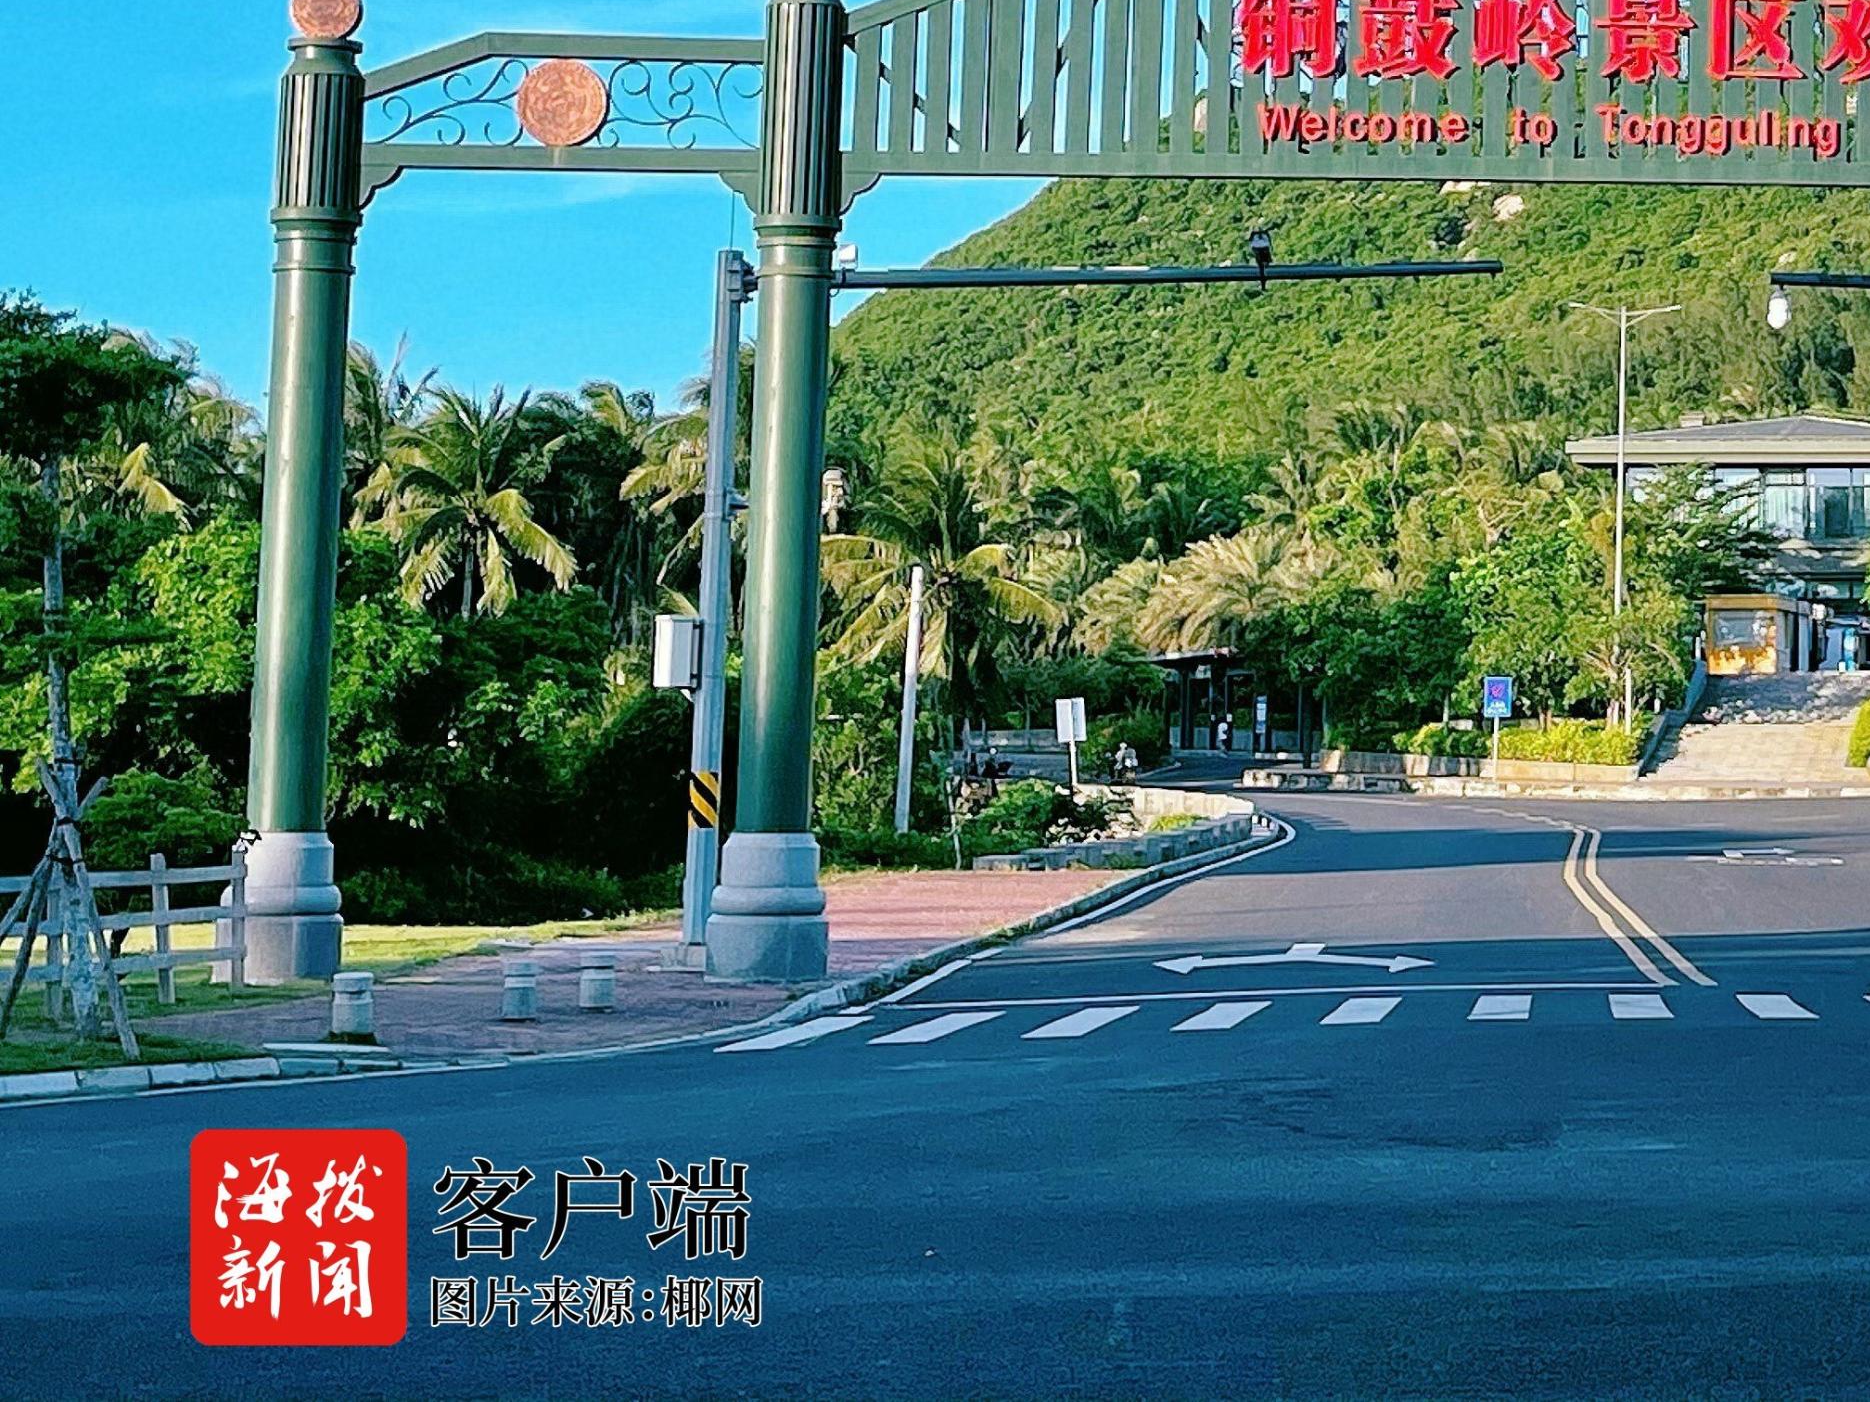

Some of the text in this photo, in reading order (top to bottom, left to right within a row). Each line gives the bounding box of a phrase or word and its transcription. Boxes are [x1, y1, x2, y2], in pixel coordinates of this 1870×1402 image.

[1257, 103, 1470, 144] Welcome
[1513, 106, 1558, 145] to
[1595, 103, 1842, 158] Tongguling
